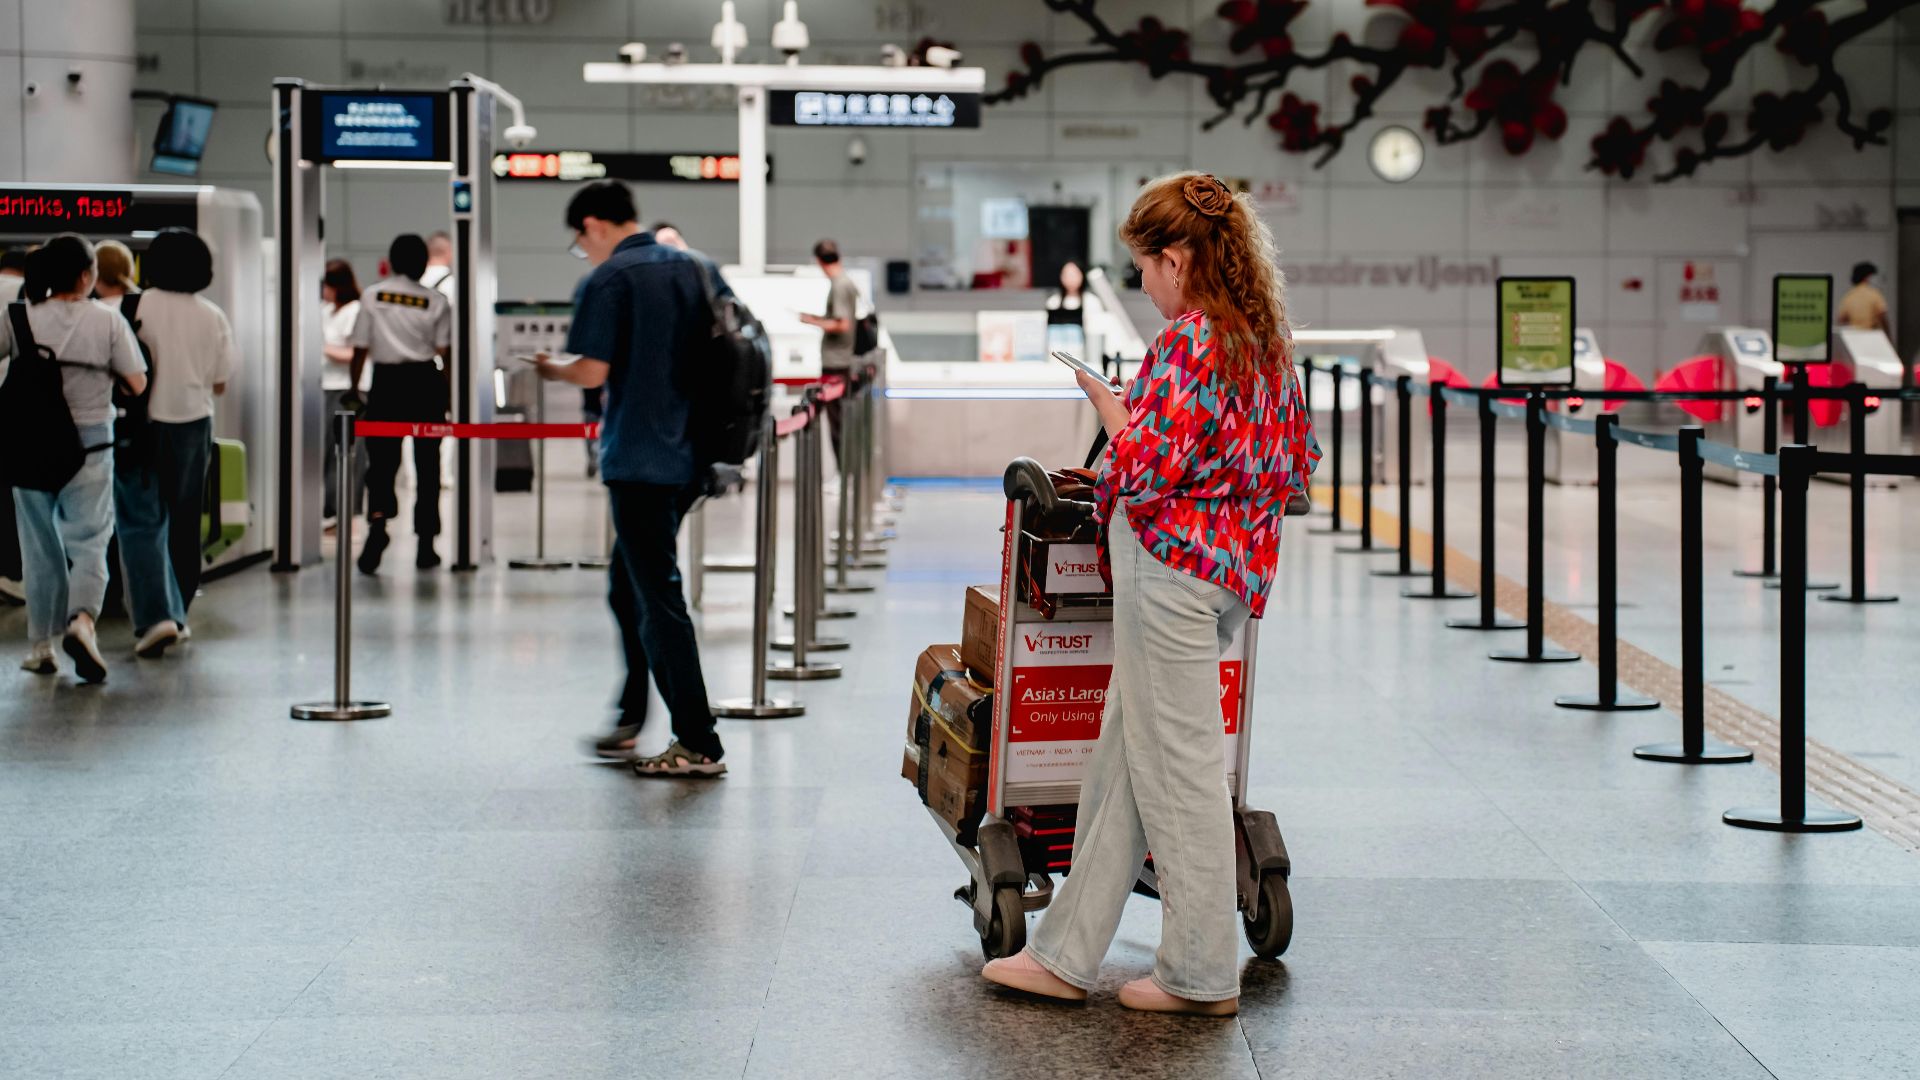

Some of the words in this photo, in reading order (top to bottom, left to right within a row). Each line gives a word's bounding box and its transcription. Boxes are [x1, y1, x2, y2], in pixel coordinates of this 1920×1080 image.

[1001, 573, 1009, 618] Helping
[1021, 687, 1066, 701] Asia's
[1030, 711, 1058, 725] Only
[1062, 709, 1095, 724] Using
